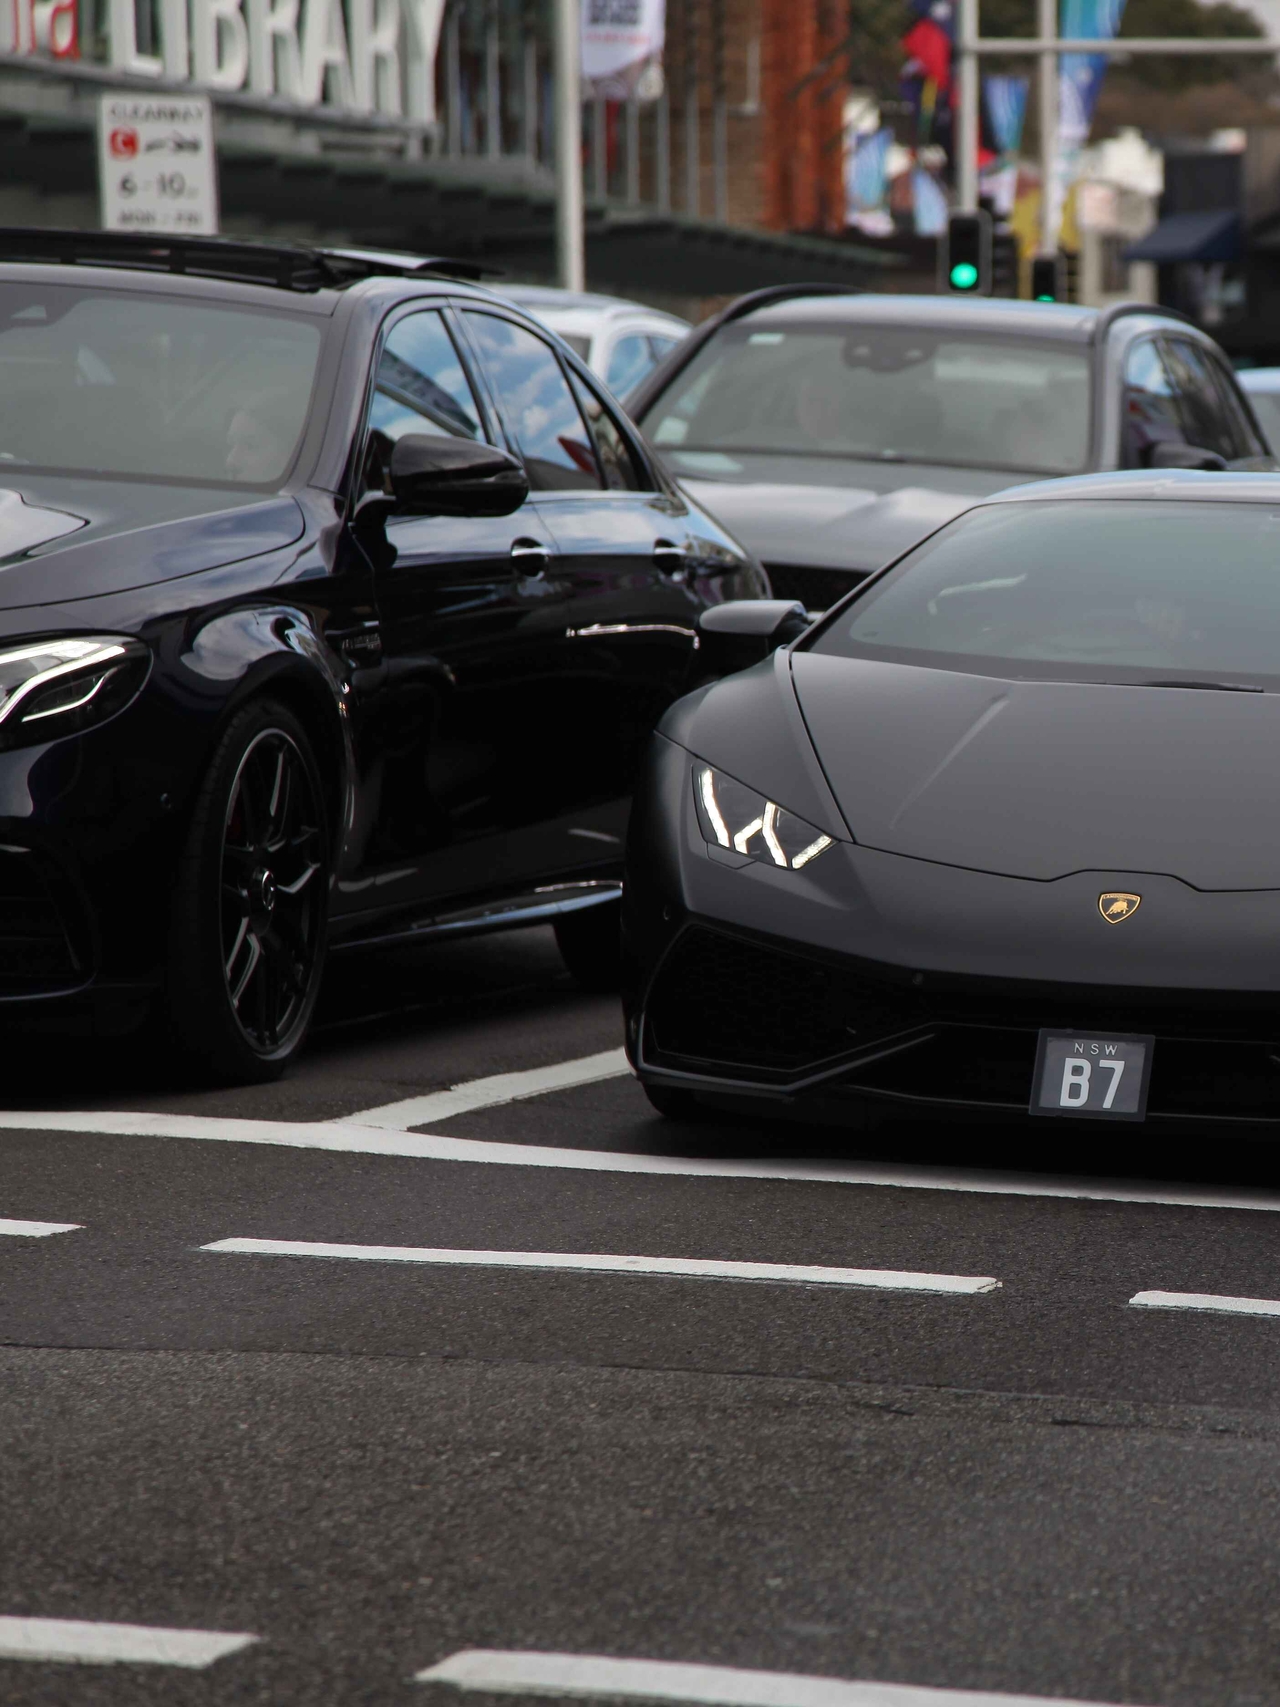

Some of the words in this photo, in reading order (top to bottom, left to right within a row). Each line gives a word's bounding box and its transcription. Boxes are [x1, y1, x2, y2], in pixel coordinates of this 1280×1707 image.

[110, 0, 448, 124] LIBRARY
[109, 102, 204, 121] CLEARWAY
[119, 172, 138, 199] 6
[158, 172, 185, 199] 10
[1074, 1042, 1118, 1056] NSW
[1060, 1057, 1126, 1109] B7
